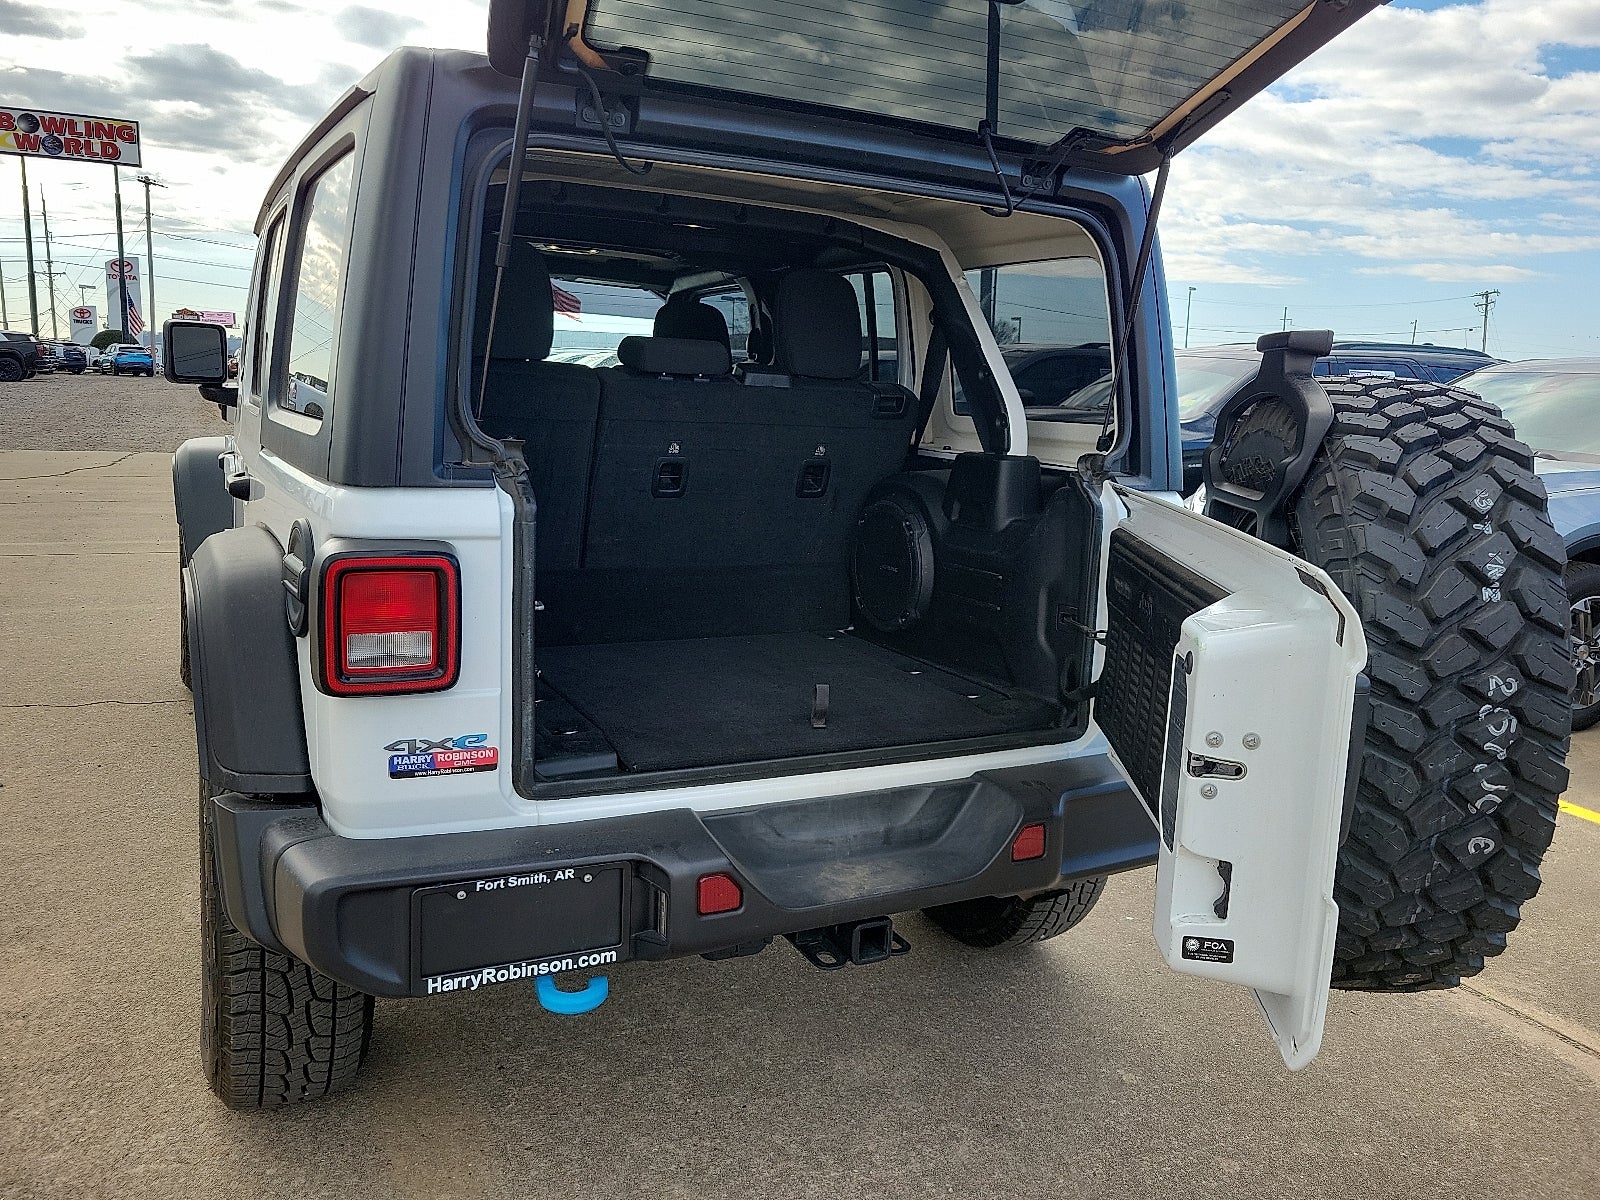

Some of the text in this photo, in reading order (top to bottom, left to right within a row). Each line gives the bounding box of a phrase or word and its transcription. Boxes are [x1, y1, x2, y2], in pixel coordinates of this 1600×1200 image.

[0, 111, 137, 144] BOWLING
[12, 132, 121, 160] WORLD
[394, 749, 494, 765] HARRY ROBINSON
[397, 763, 430, 771] BUICK
[476, 868, 575, 892] Fort Smith, AR
[427, 950, 617, 995] HarryRobinson.com
